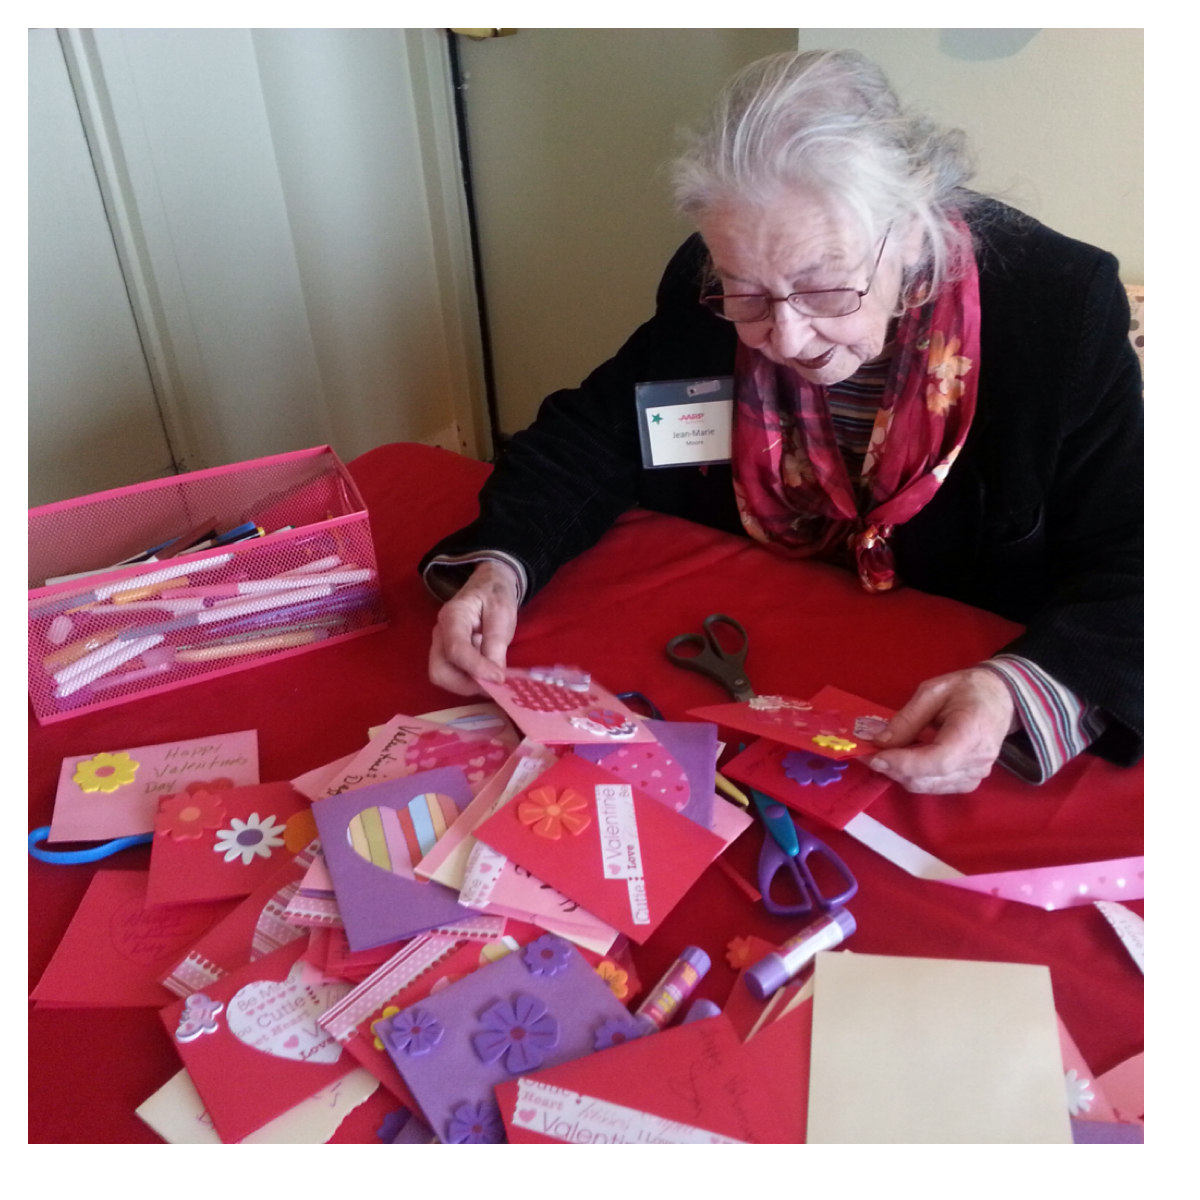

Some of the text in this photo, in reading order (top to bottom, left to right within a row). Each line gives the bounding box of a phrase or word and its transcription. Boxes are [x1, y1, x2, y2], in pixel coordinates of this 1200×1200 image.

[673, 429, 715, 439] Jean-Marie
[164, 744, 222, 760] Happy
[144, 779, 177, 794] Day
[602, 788, 622, 860] Valentine
[627, 844, 637, 870] Love
[237, 976, 296, 1012] Be Mine
[257, 997, 306, 1028] Cutie
